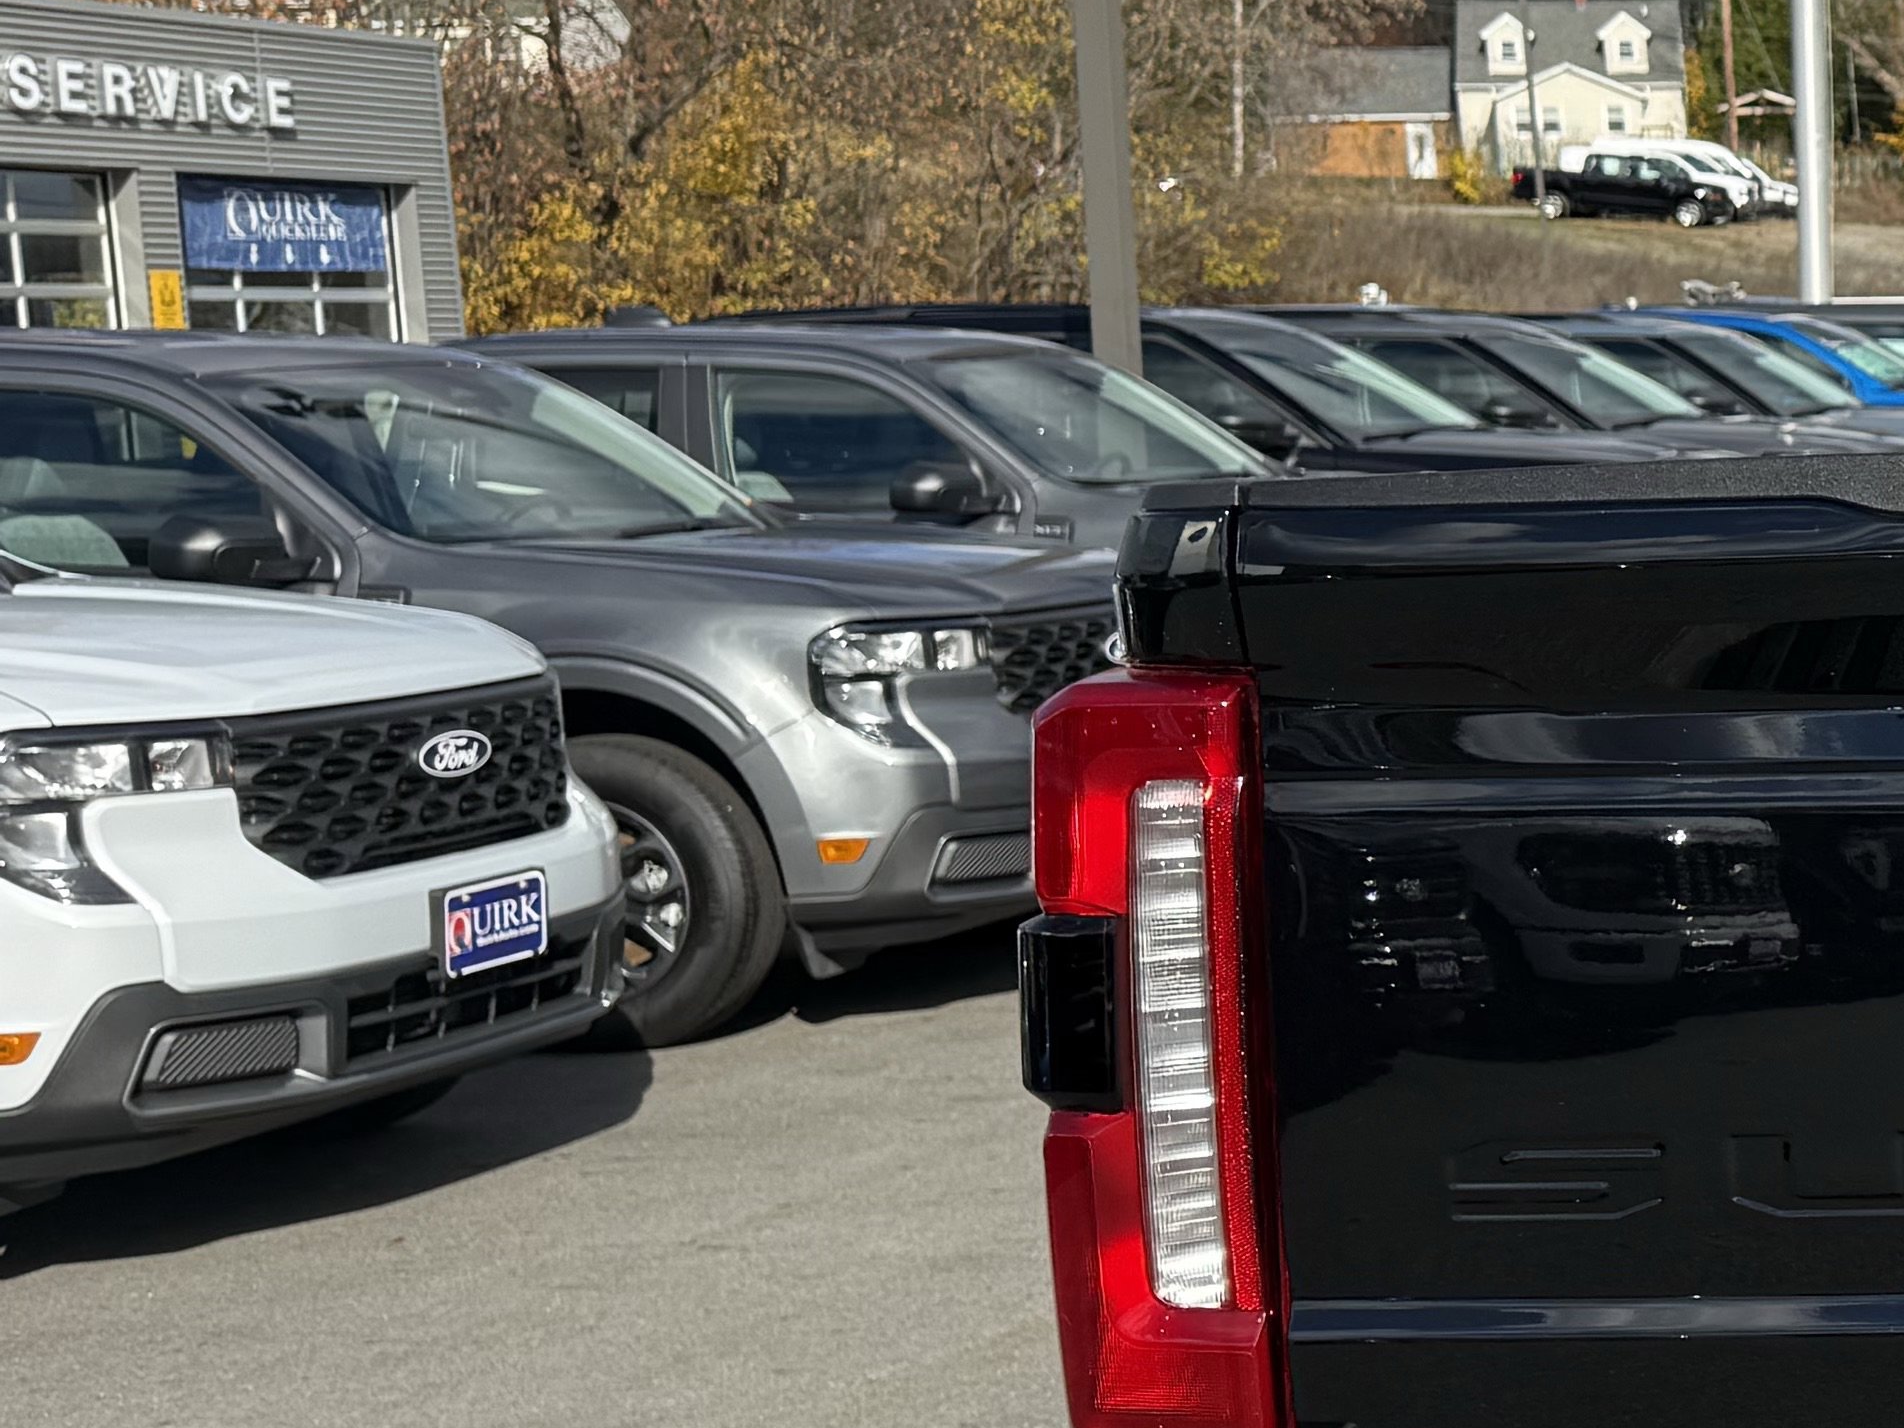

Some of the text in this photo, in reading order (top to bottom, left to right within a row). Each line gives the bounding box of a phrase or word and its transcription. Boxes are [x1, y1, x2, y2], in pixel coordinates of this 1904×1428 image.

[7, 53, 296, 127] SERVICE
[434, 737, 479, 771] Ford
[449, 892, 542, 957] QUIRK
